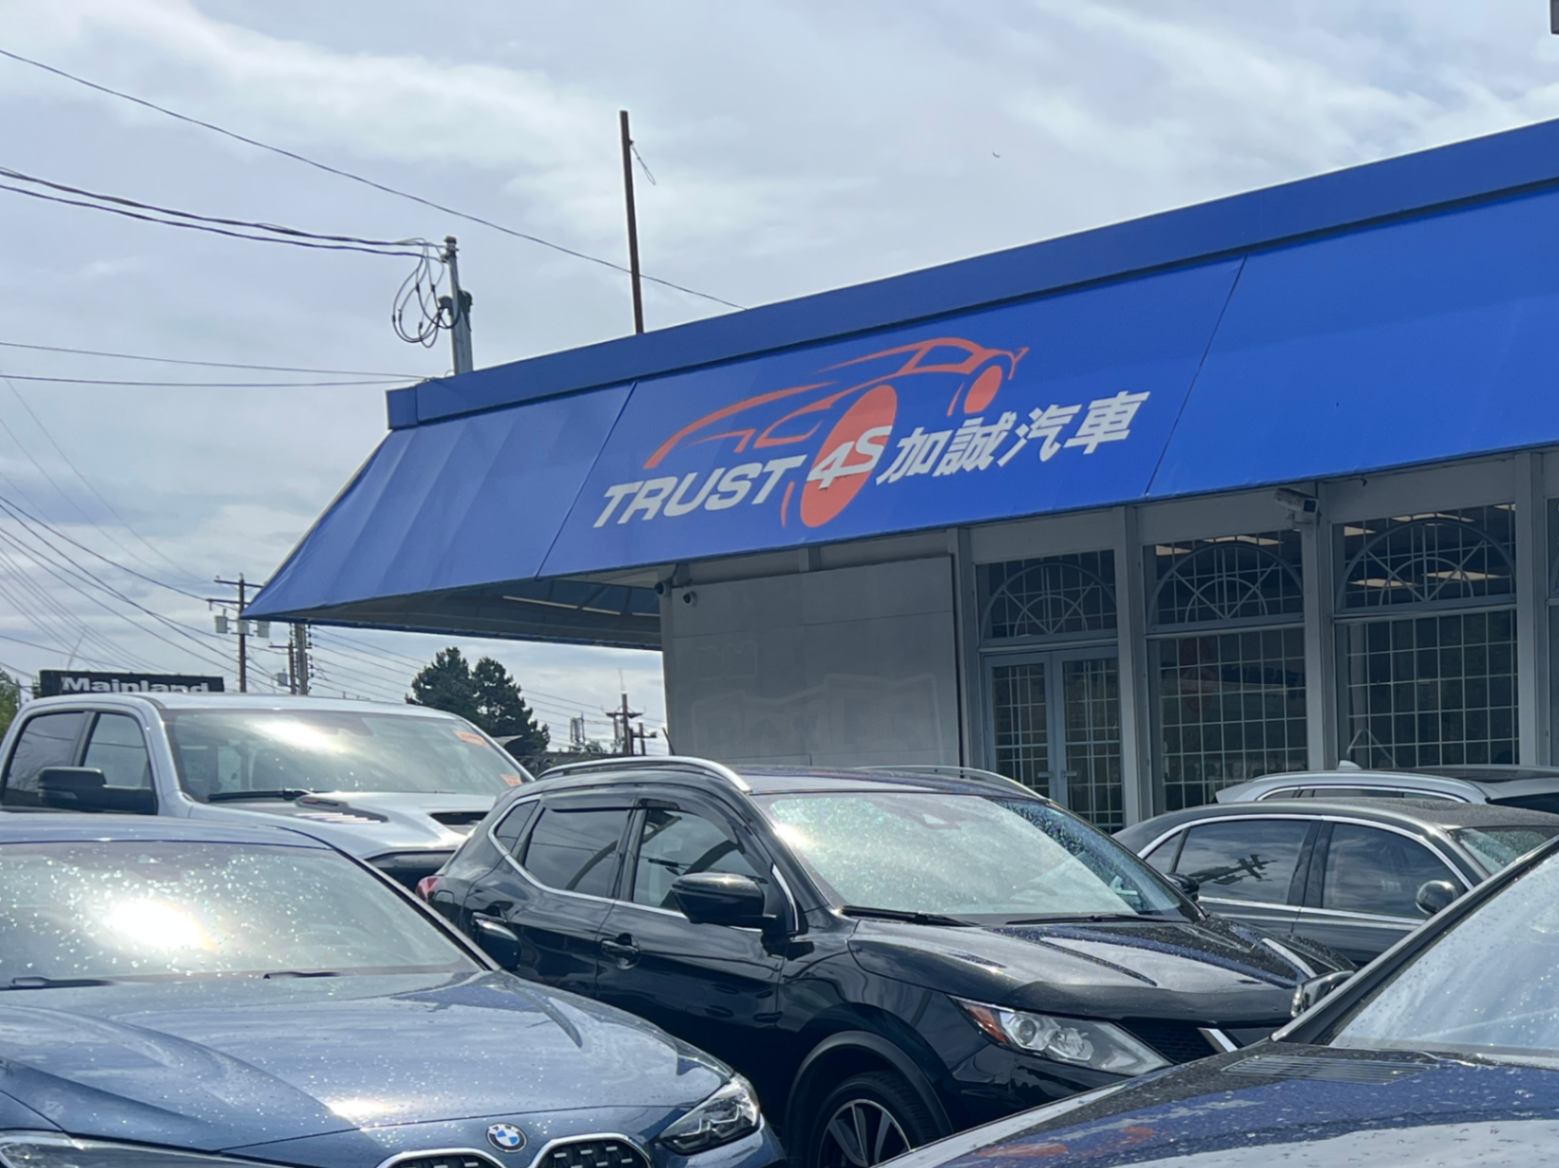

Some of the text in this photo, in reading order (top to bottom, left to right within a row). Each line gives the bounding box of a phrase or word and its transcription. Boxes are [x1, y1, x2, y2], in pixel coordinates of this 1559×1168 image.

[593, 391, 1150, 528] TRUST 4S 加誠汽車
[61, 677, 208, 693] Mainland
